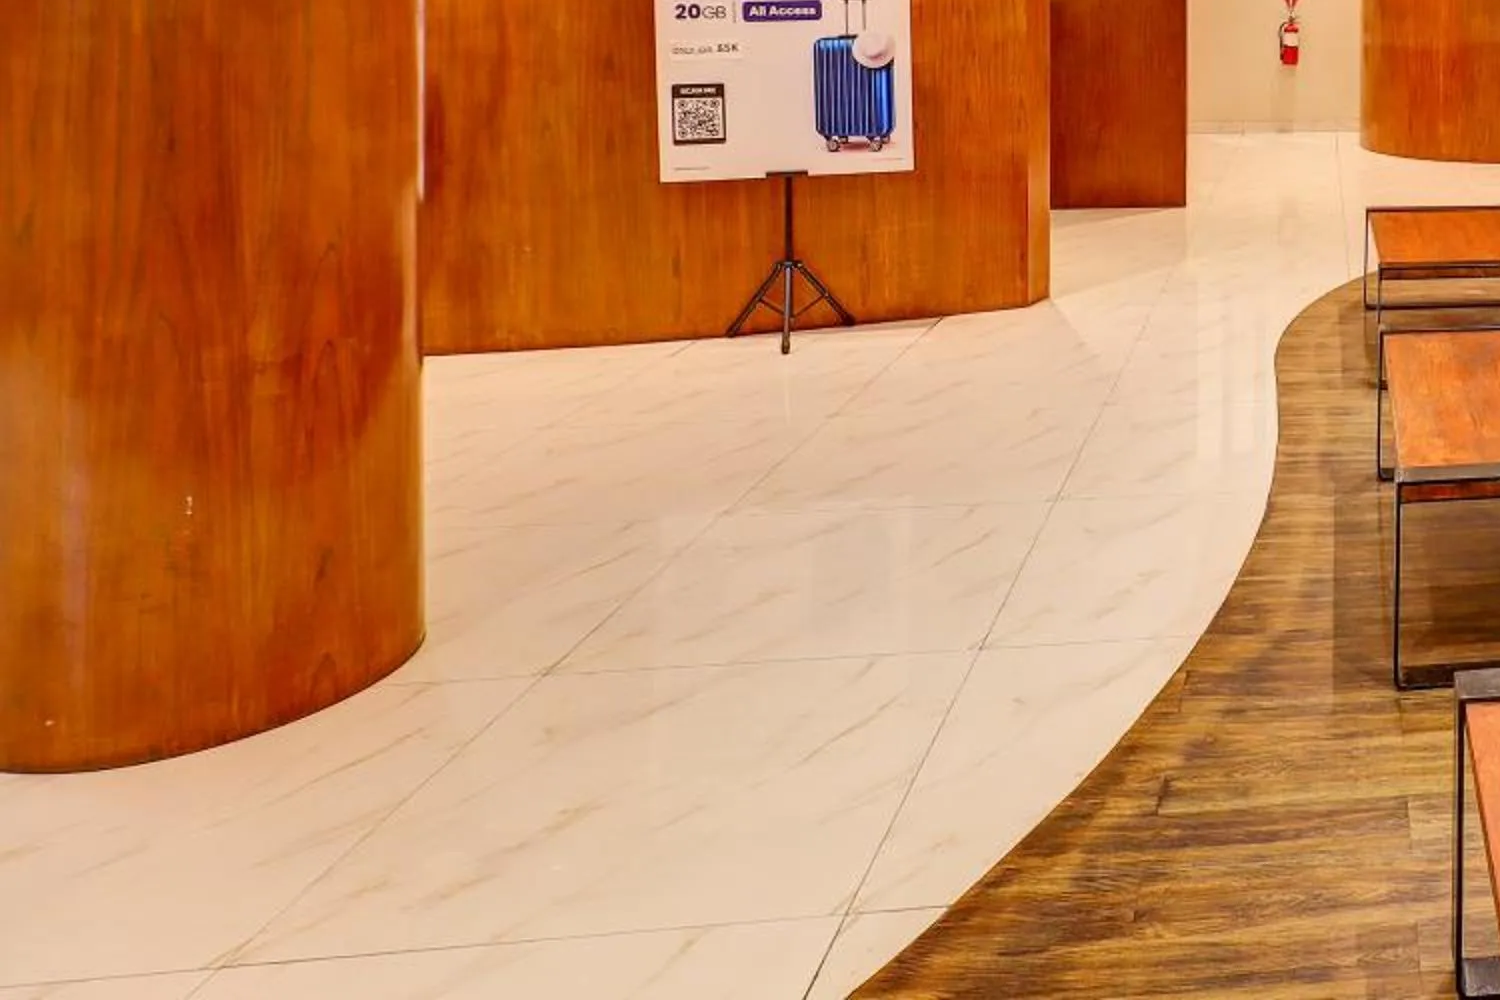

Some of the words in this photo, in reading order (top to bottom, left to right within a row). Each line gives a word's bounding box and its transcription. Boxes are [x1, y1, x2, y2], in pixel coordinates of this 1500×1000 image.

[675, 4, 727, 19] 20GB
[749, 5, 767, 17] All
[769, 5, 817, 17] Access
